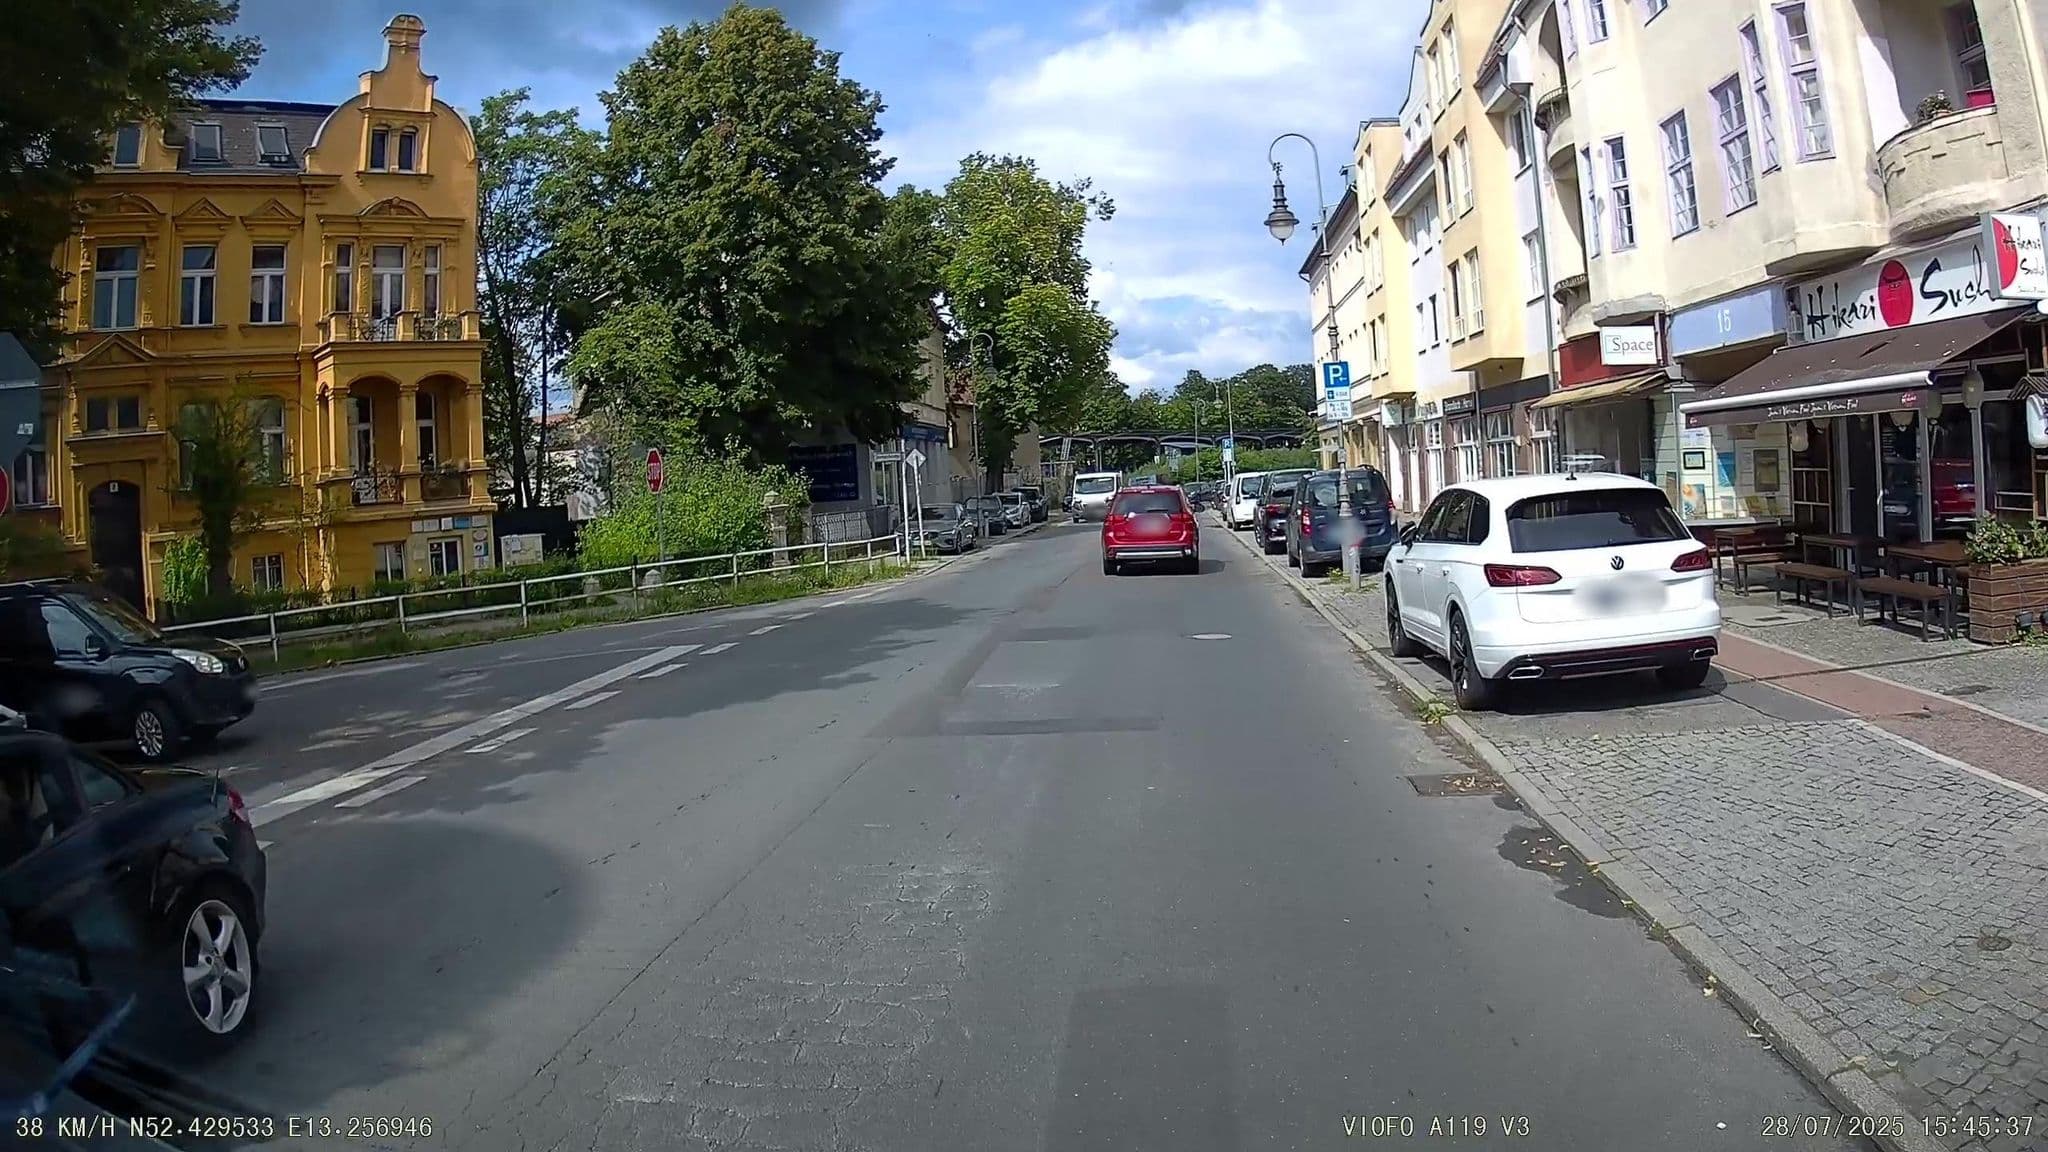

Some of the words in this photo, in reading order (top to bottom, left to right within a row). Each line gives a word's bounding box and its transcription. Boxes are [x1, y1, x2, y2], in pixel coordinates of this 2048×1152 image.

[1806, 282, 1876, 339] Hikari
[1919, 244, 1999, 316] Sush
[1717, 309, 1732, 333] 15
[1612, 337, 1654, 355] Space
[1329, 365, 1344, 385] P
[648, 463, 661, 481] STOP
